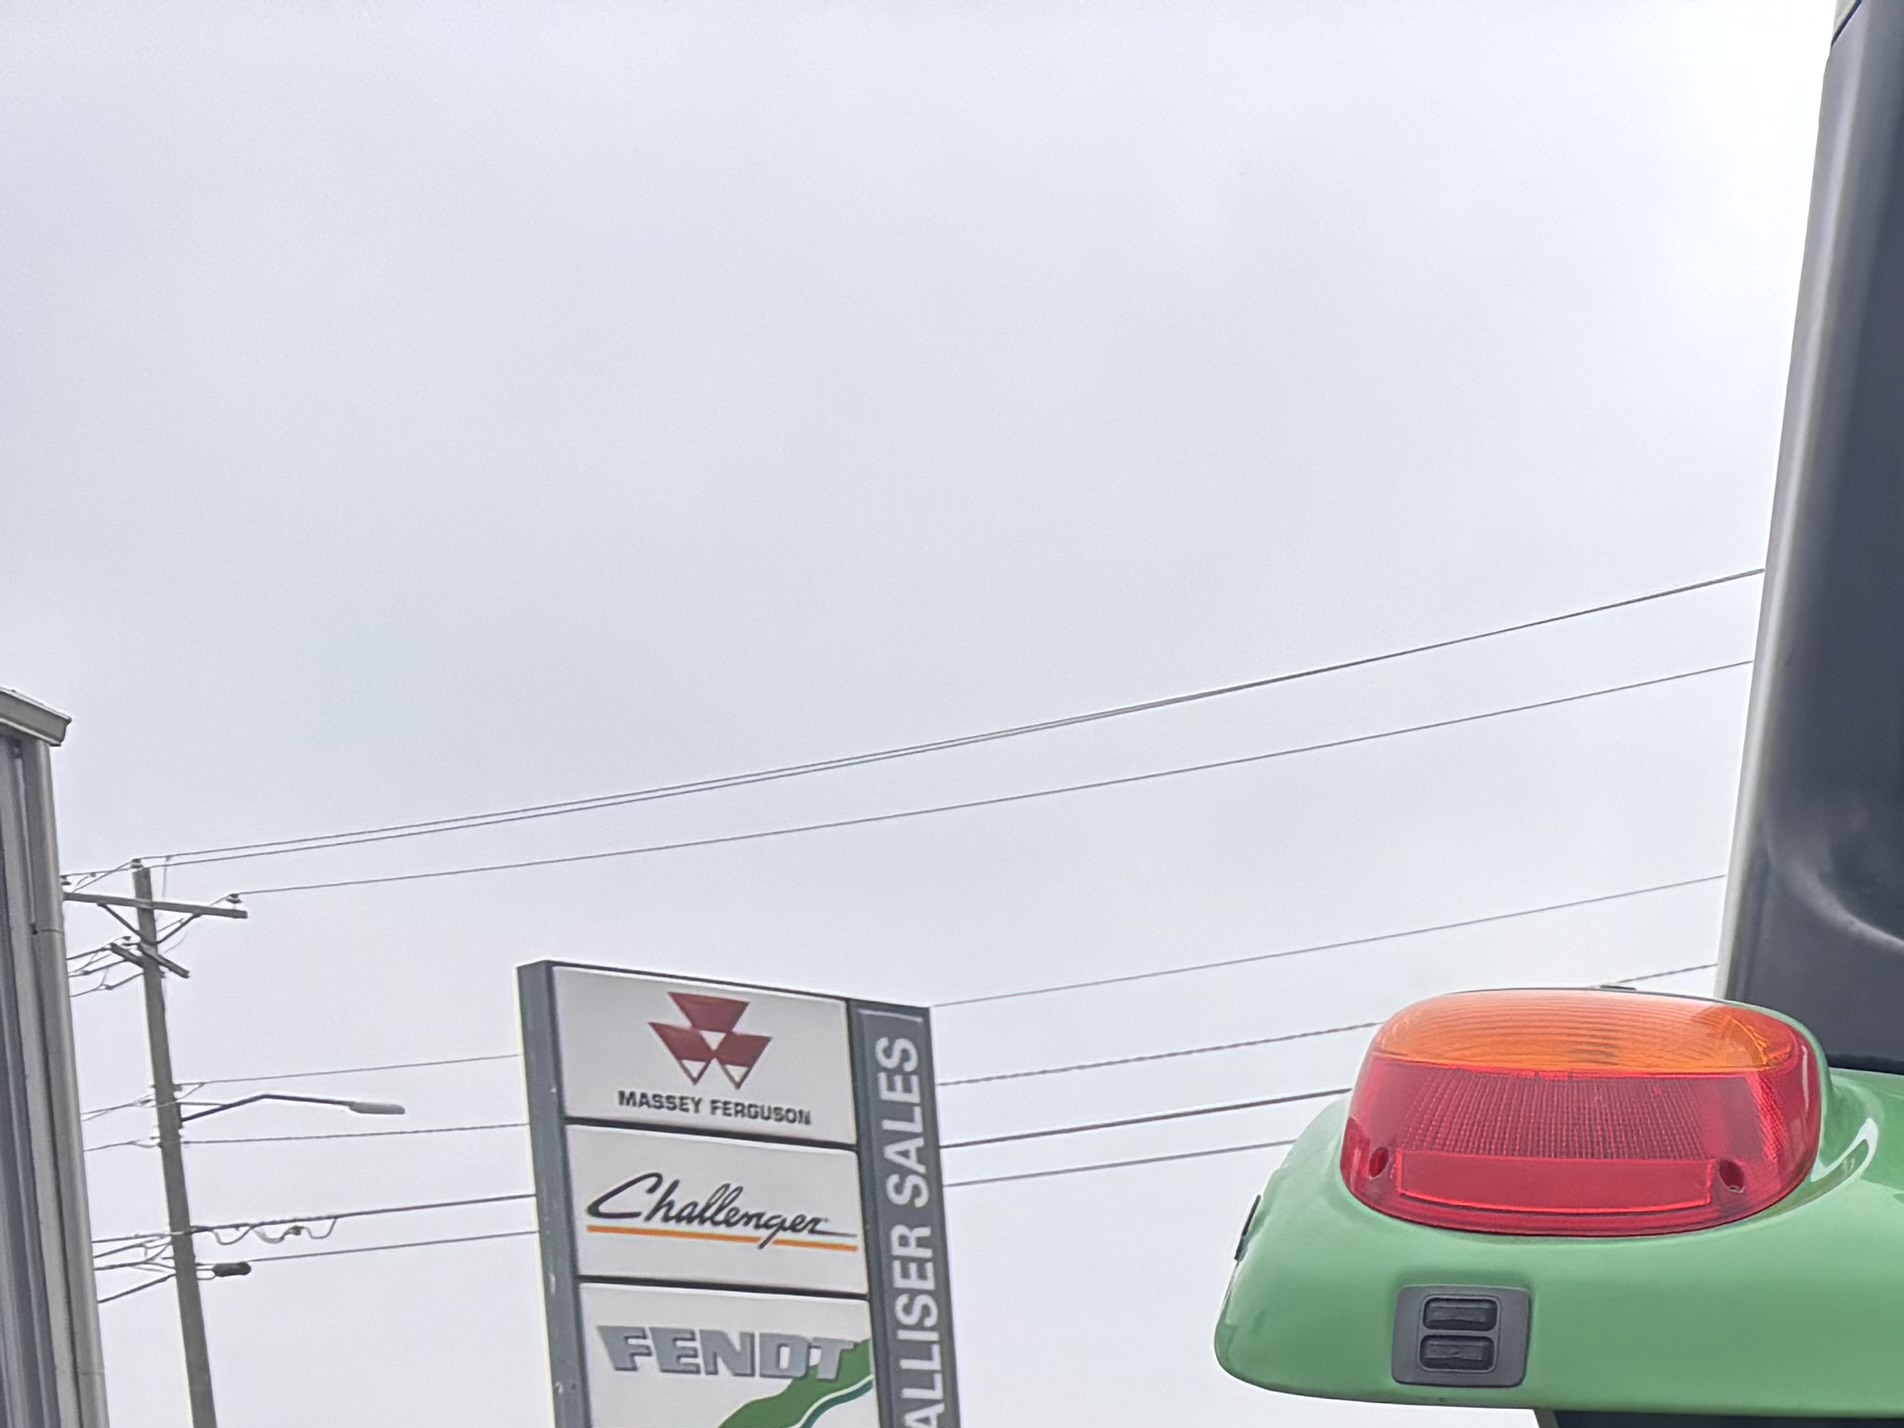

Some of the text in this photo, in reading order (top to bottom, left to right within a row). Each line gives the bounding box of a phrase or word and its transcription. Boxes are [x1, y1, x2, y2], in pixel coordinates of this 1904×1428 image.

[617, 1090, 812, 1125] MASSEY FERGUSON
[874, 1036, 930, 1208] SALES
[586, 1172, 858, 1249] Challenger
[596, 1325, 855, 1381] FENDT
